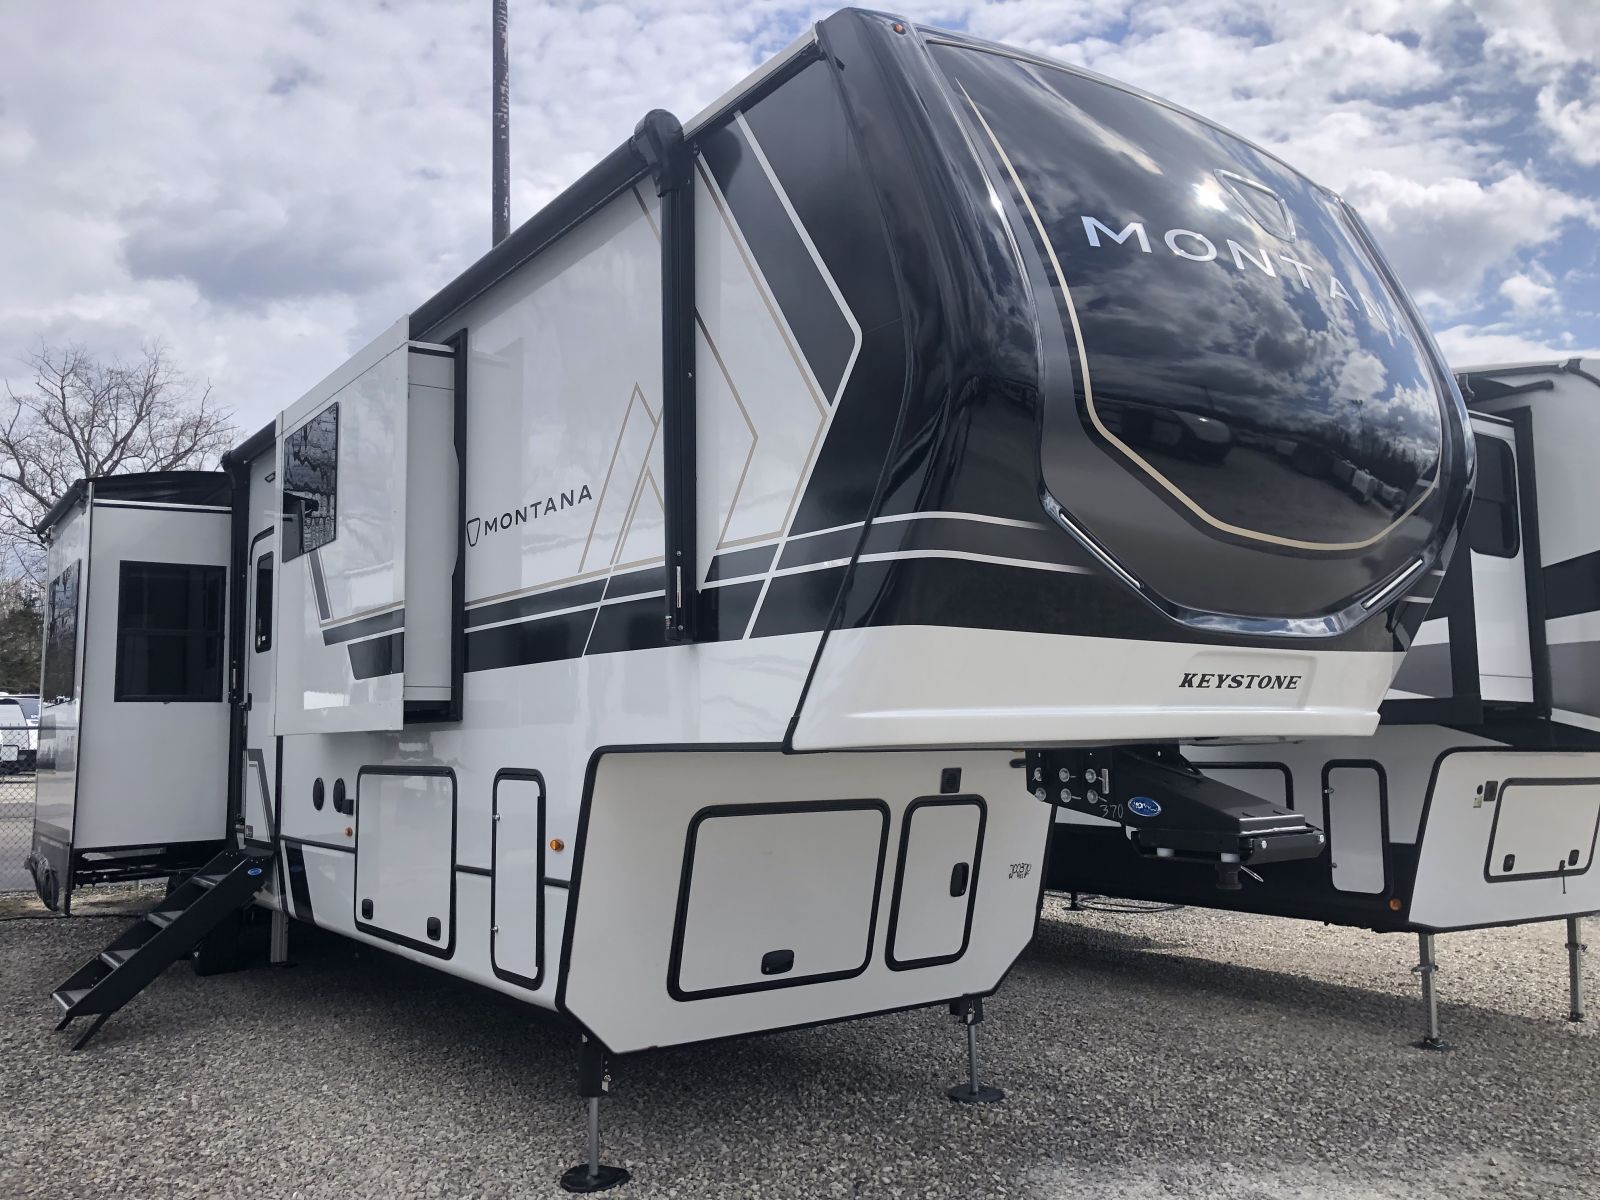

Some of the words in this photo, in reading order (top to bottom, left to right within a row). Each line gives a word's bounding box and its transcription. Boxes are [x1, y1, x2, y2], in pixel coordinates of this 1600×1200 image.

[1080, 215, 1409, 346] MONTANA
[484, 484, 593, 536] MONTANA
[1178, 672, 1302, 690] KEYSTONE
[1099, 803, 1124, 819] 370
